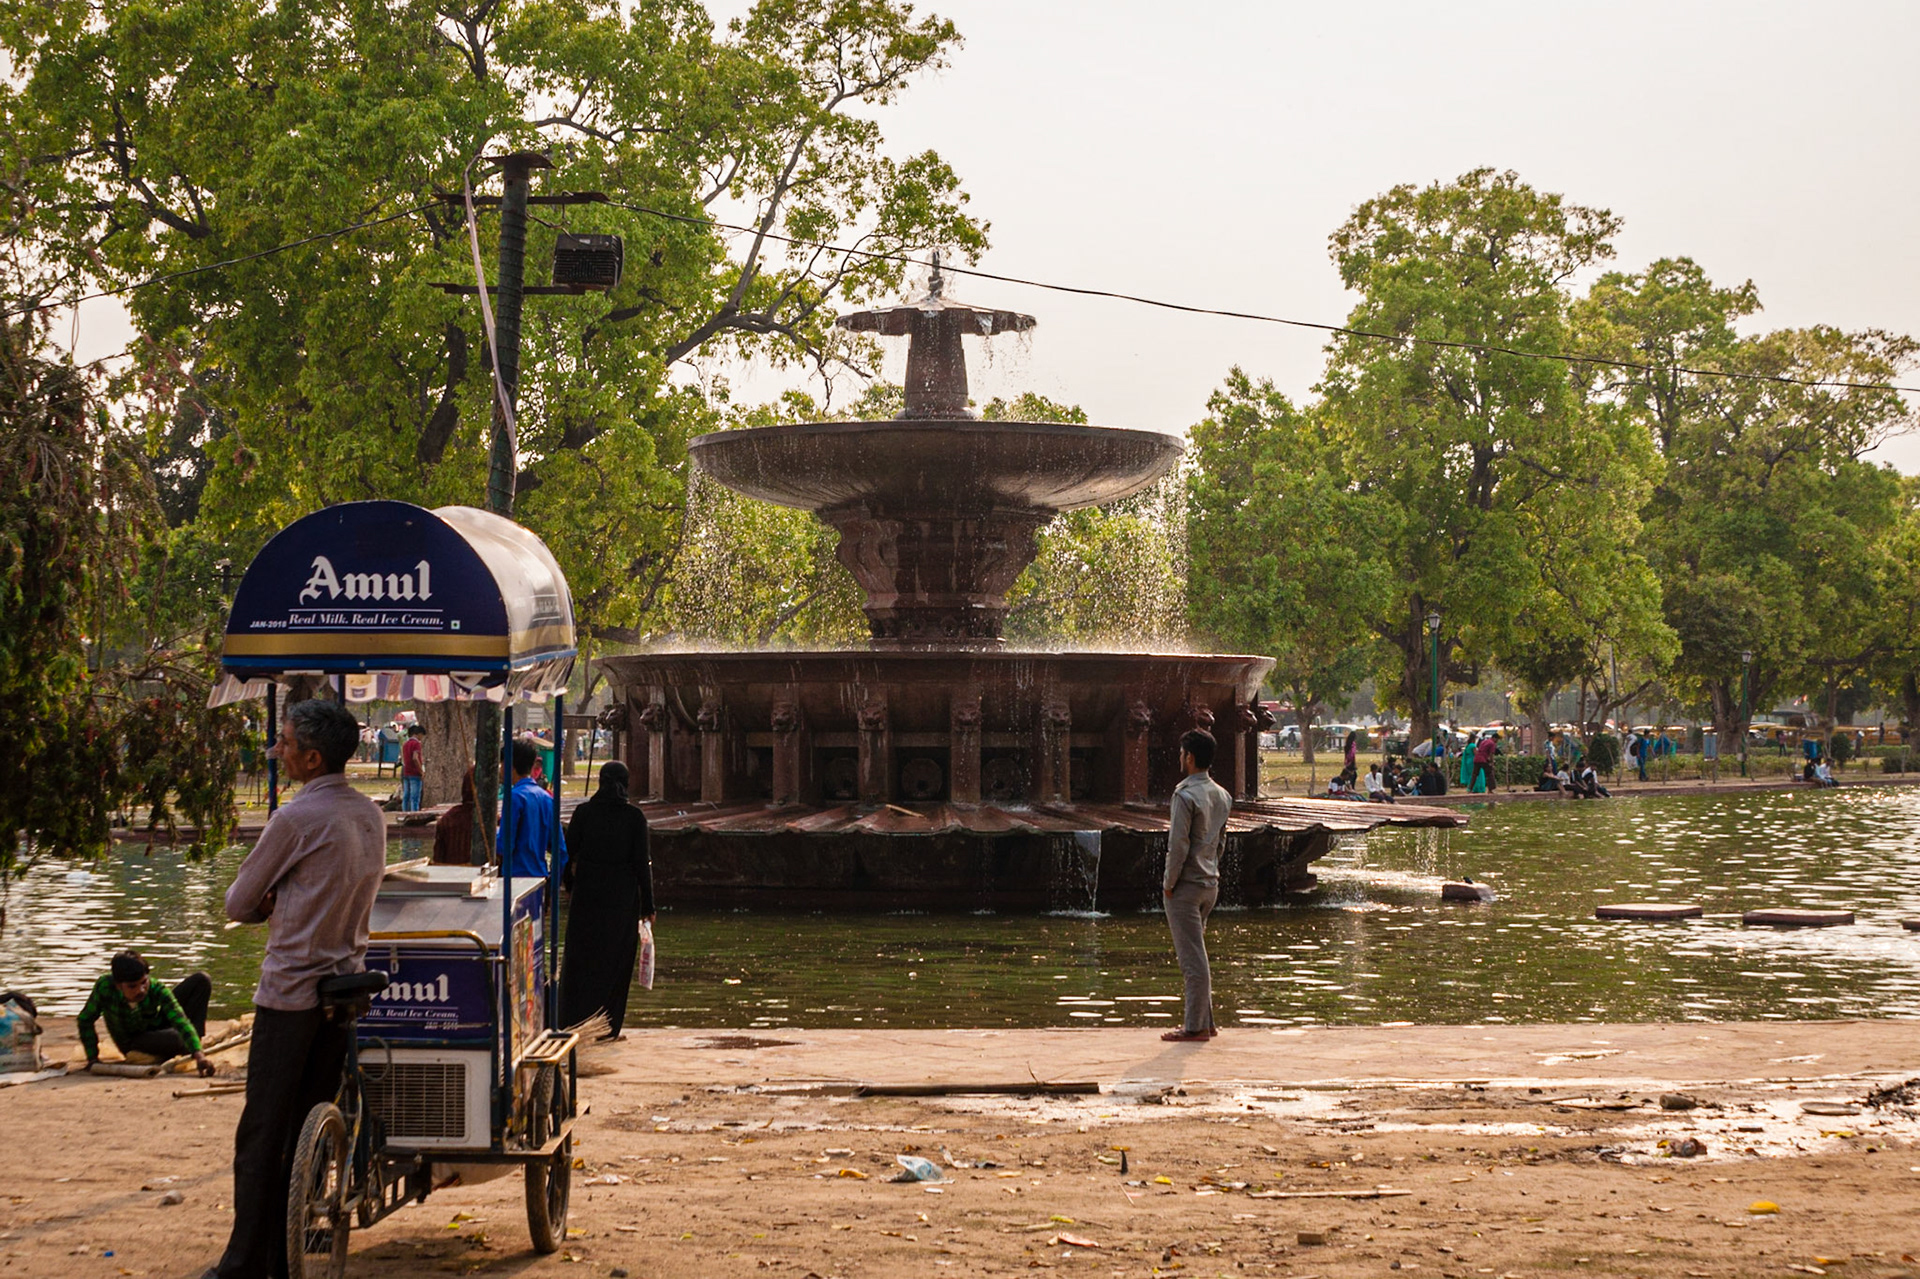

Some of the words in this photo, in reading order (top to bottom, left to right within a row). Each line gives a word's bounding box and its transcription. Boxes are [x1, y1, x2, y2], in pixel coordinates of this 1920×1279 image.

[299, 555, 433, 606] Amul
[289, 613, 317, 625] Real
[319, 613, 349, 625] Milk.
[352, 613, 379, 625] Real
[381, 613, 399, 625] Ice
[401, 613, 444, 626] Cream.
[368, 973, 451, 1003] mul
[365, 1008, 384, 1018] ilk.
[386, 1009, 408, 1018] Real
[409, 1009, 424, 1018] Ice
[425, 1009, 459, 1019] Cream.
